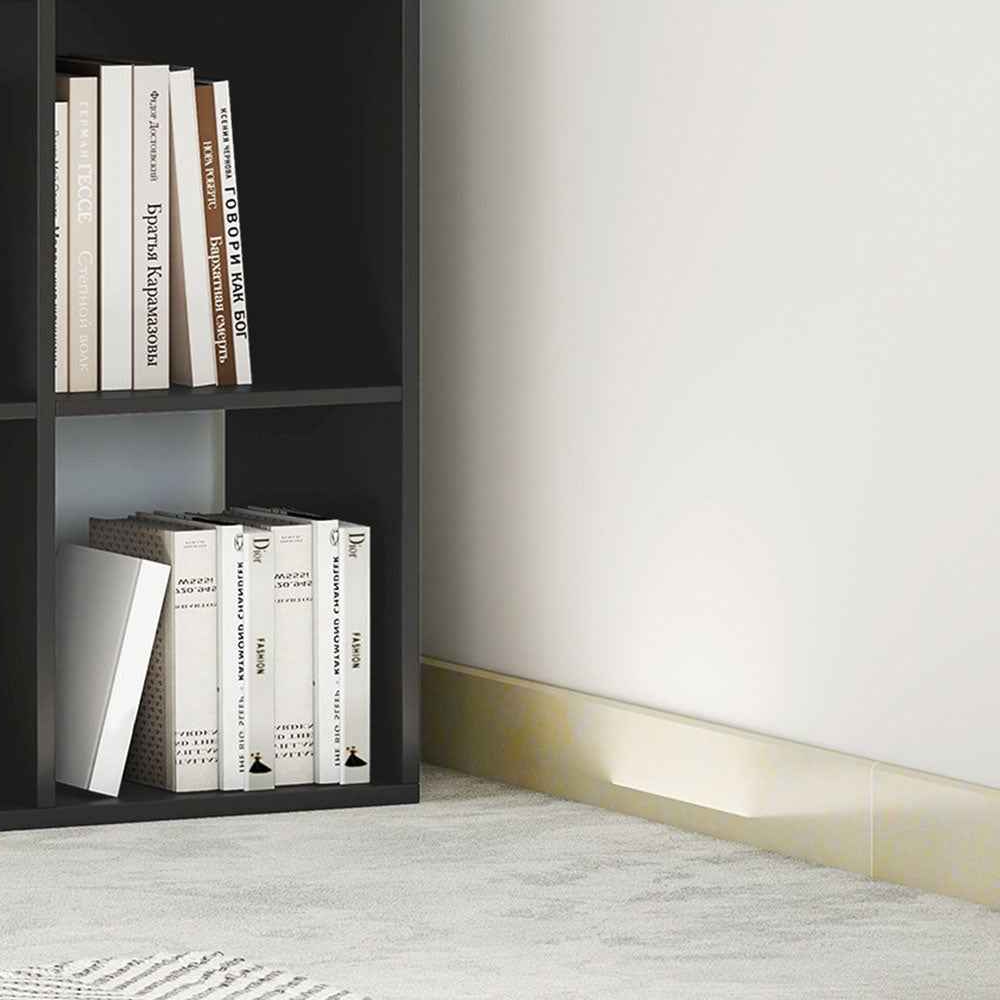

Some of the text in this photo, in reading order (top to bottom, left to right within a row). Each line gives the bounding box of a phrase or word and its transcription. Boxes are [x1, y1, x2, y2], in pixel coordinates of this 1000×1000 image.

[220, 108, 232, 180] КСЕНИЯ ЧЕРНОВА
[77, 163, 92, 225] ГЕССЕ
[205, 167, 217, 210] РОБЕРТС
[78, 250, 92, 328] Степной
[142, 203, 163, 367] Братья Карамазовы
[224, 187, 247, 340] ГОВОРИ КАК БОГ
[208, 236, 228, 364] Бархатная смерть
[253, 538, 271, 564] Dior
[348, 533, 366, 558] Dior
[255, 638, 265, 674] FASHION
[351, 632, 361, 668] FASHION
